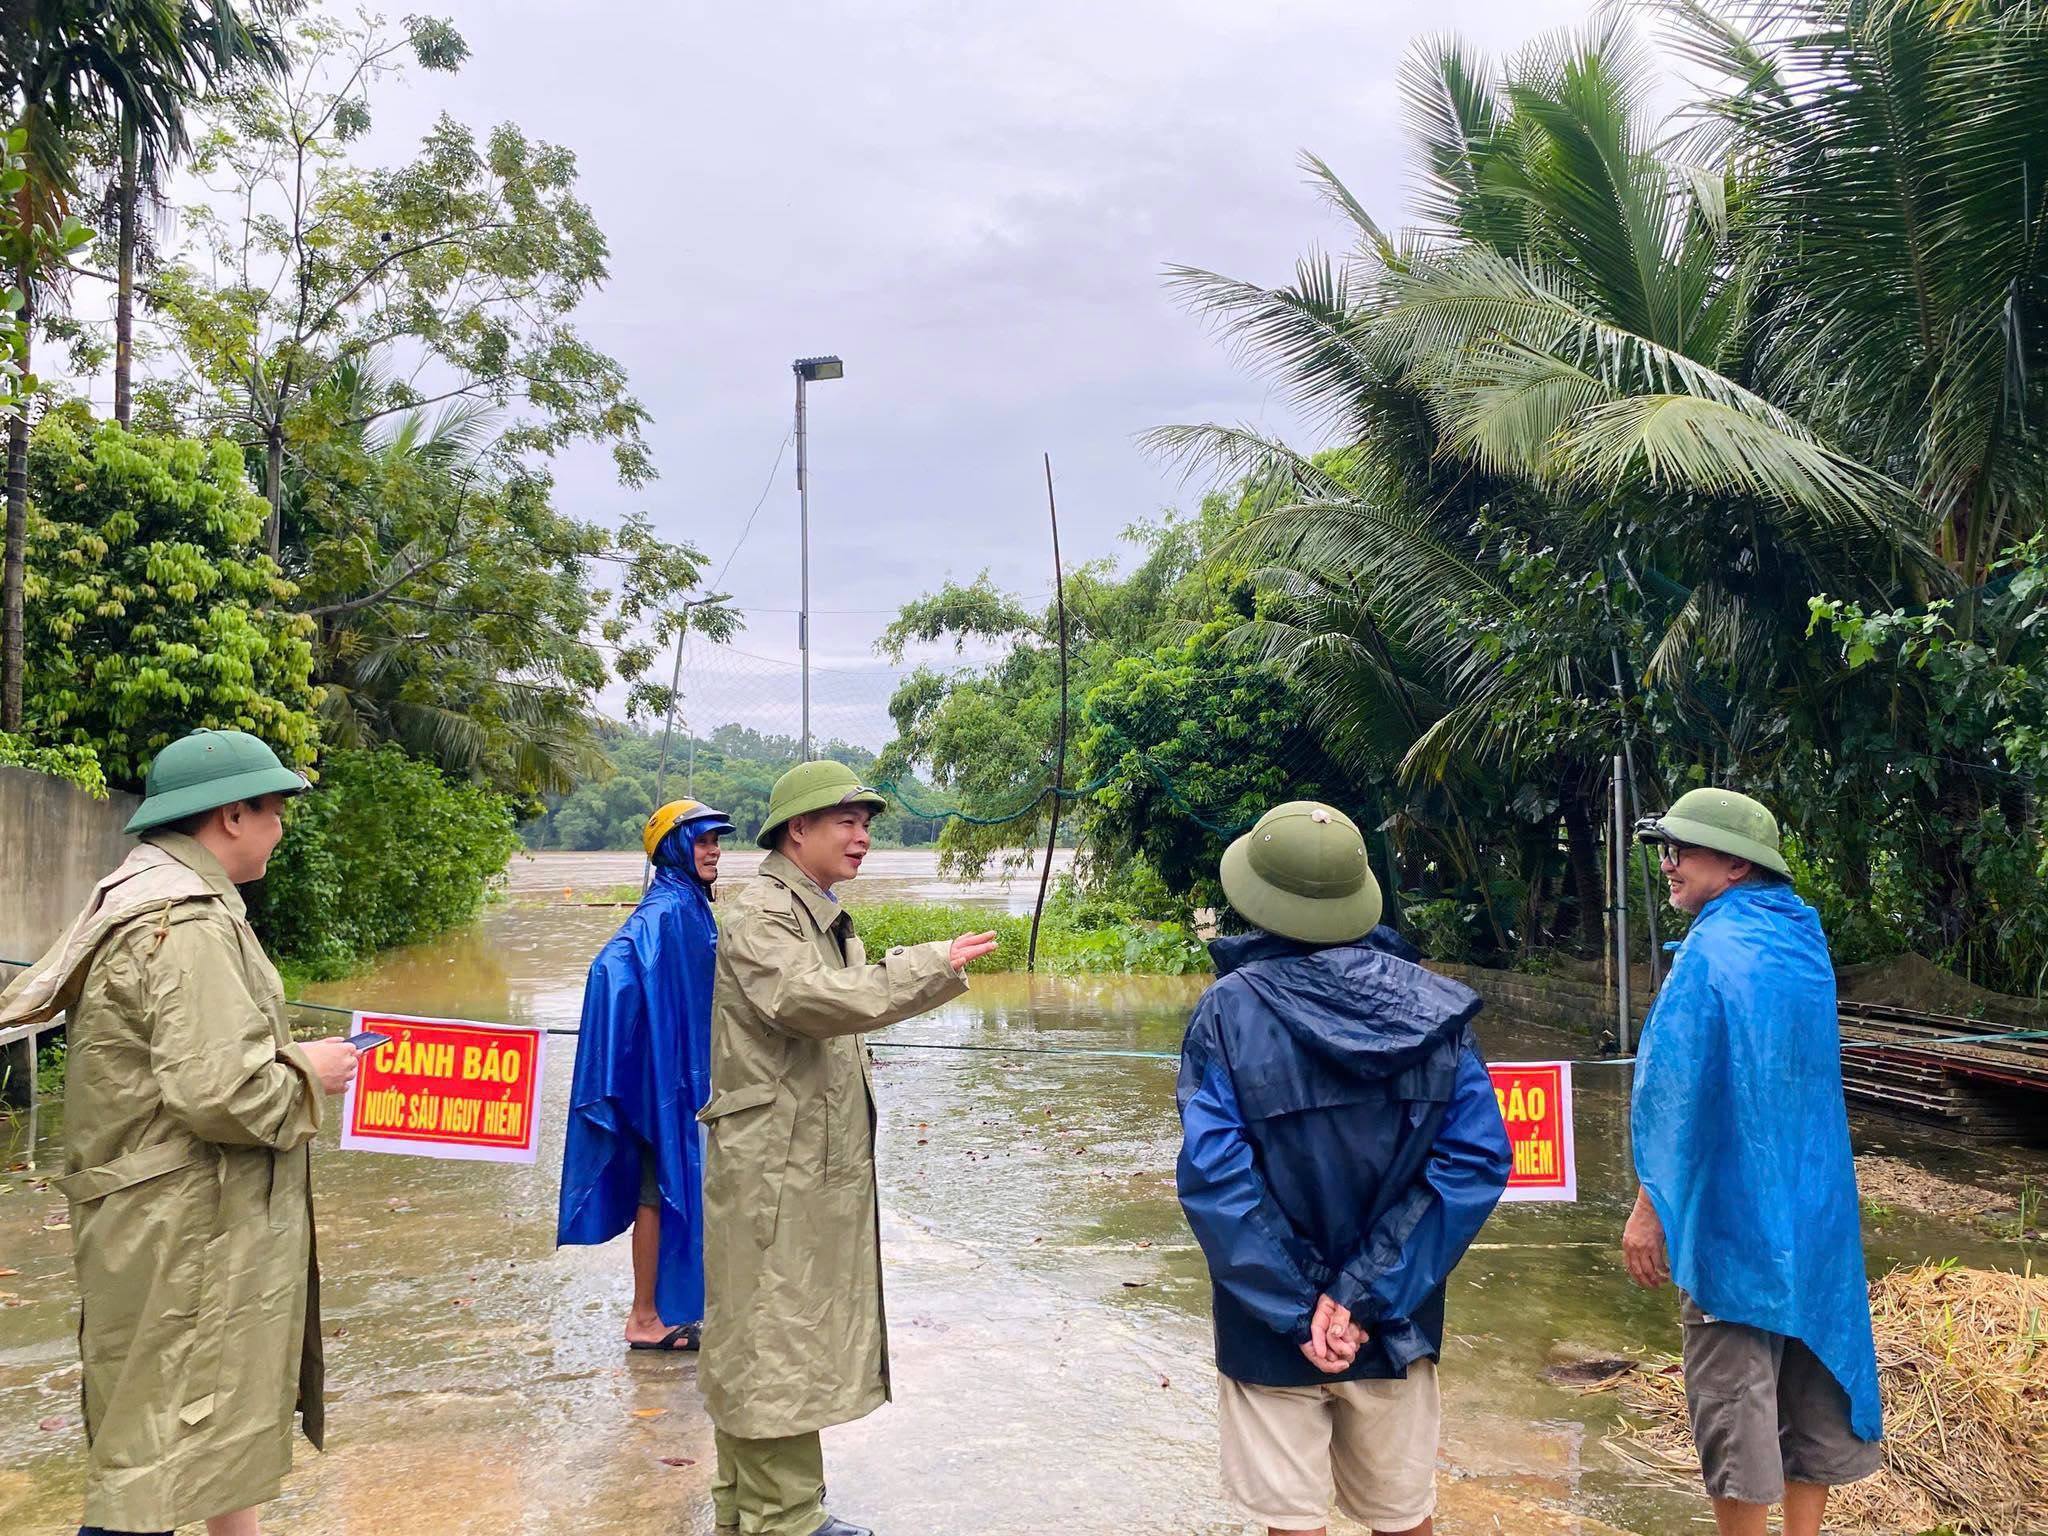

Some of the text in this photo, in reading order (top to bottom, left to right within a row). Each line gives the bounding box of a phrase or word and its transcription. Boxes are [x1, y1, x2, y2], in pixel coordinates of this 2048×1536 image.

[375, 1030, 521, 1084] CẢNH BÁO
[364, 1085, 522, 1137] NƯỚC SÂU NGUY HIỂM
[1515, 1125, 1554, 1175] HIỂM
